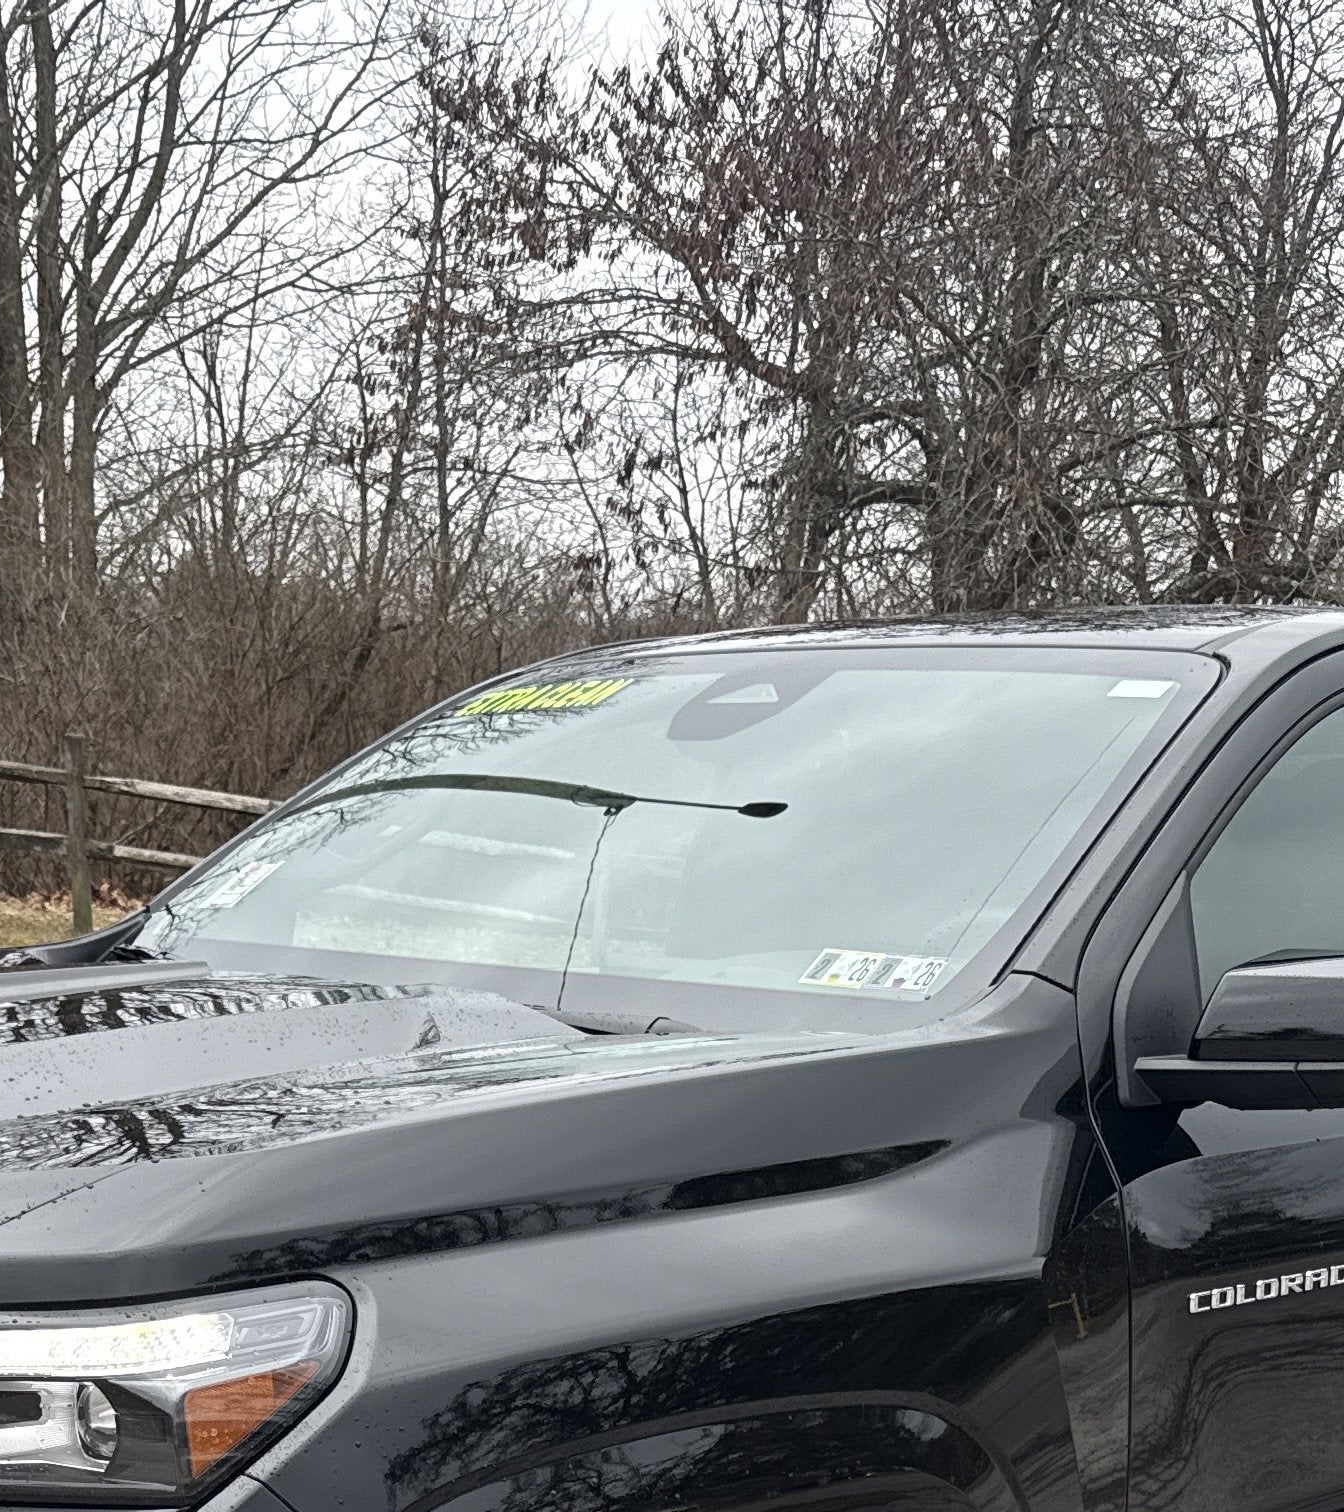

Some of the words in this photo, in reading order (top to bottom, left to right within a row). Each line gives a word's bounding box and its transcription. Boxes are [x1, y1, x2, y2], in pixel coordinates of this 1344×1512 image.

[453, 685, 554, 717] EXTRA
[526, 678, 634, 709] CLEAN
[848, 957, 876, 982] 26
[913, 961, 943, 987] 26
